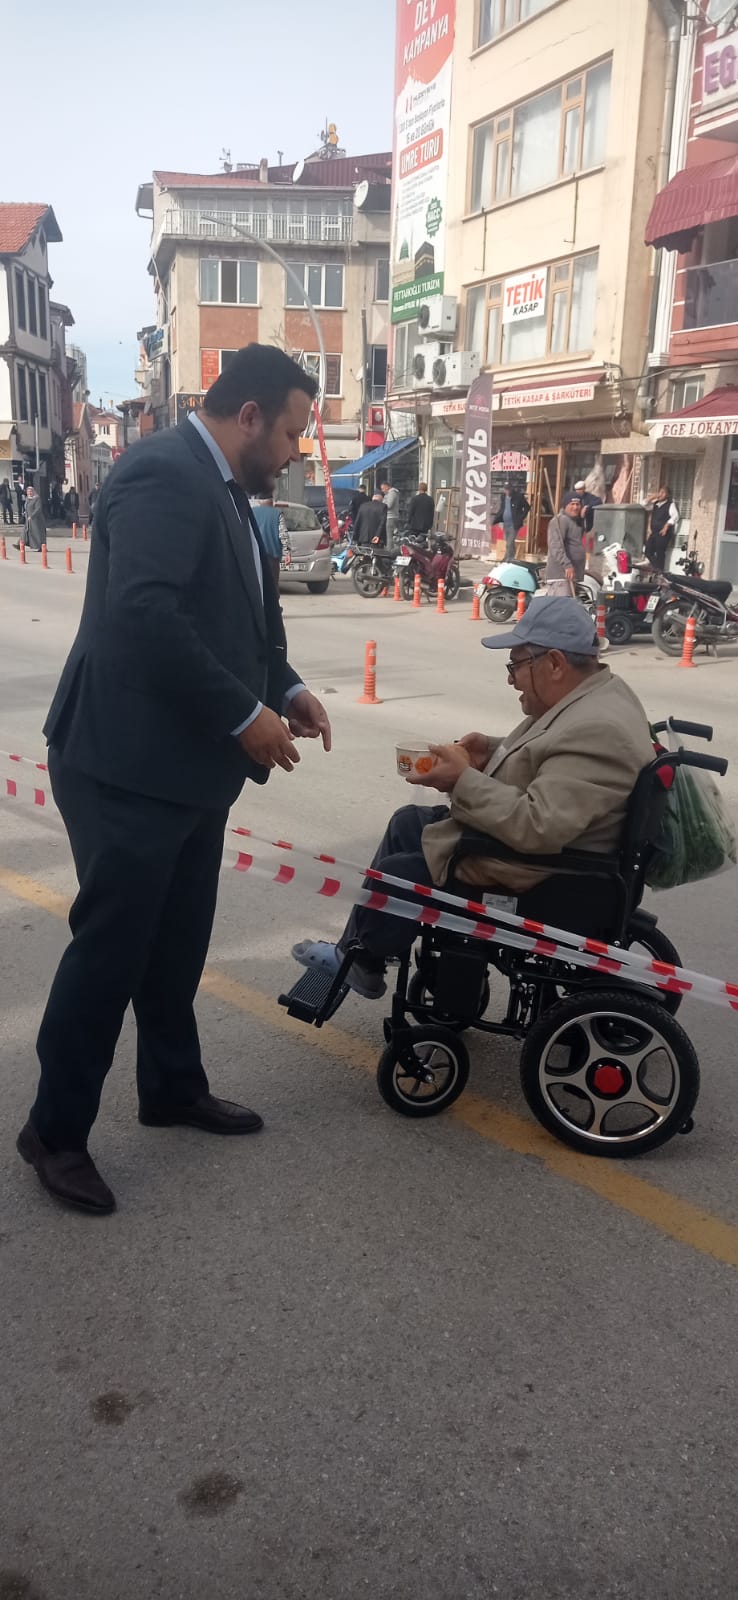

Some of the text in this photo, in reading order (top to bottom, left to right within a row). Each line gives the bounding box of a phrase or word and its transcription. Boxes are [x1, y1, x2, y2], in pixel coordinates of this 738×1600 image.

[413, 0, 438, 32] DEV
[403, 14, 449, 66] KAMPANYA
[401, 135, 440, 176] UMRE TURU
[506, 273, 545, 307] TETİK
[512, 302, 539, 316] KASAP
[503, 396, 521, 406] TETİK
[522, 394, 544, 404] KASAP
[662, 423, 686, 436] EGE
